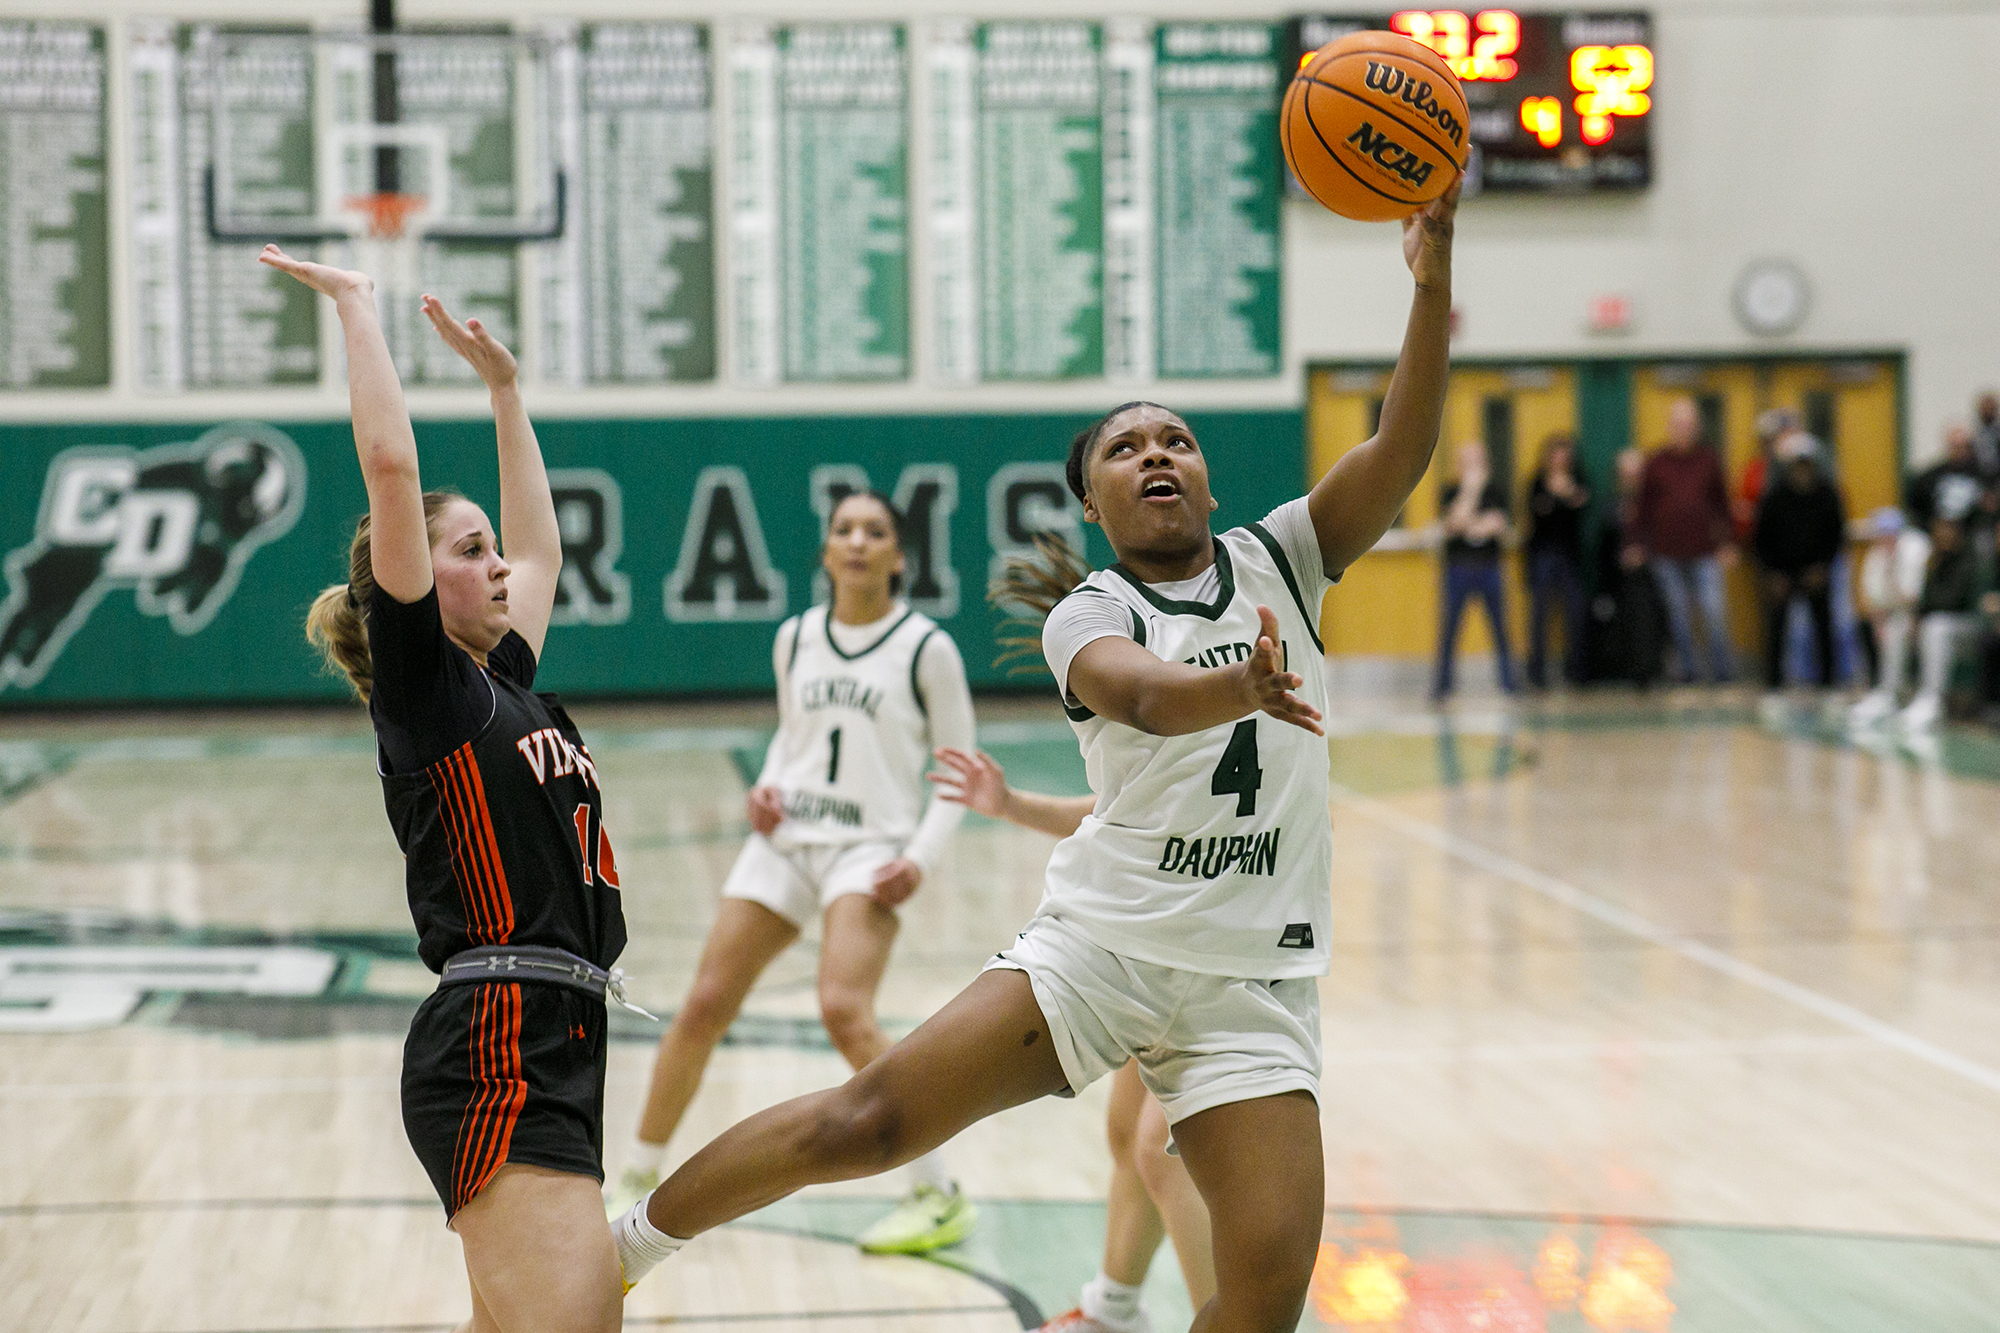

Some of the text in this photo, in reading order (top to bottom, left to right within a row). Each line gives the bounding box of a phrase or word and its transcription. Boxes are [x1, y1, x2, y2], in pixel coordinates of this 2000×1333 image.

[1365, 60, 1463, 148] Wilson
[1346, 120, 1436, 188] NCAA
[547, 463, 1086, 623] RAMS
[829, 728, 842, 784] 1
[1211, 718, 1263, 818] 4
